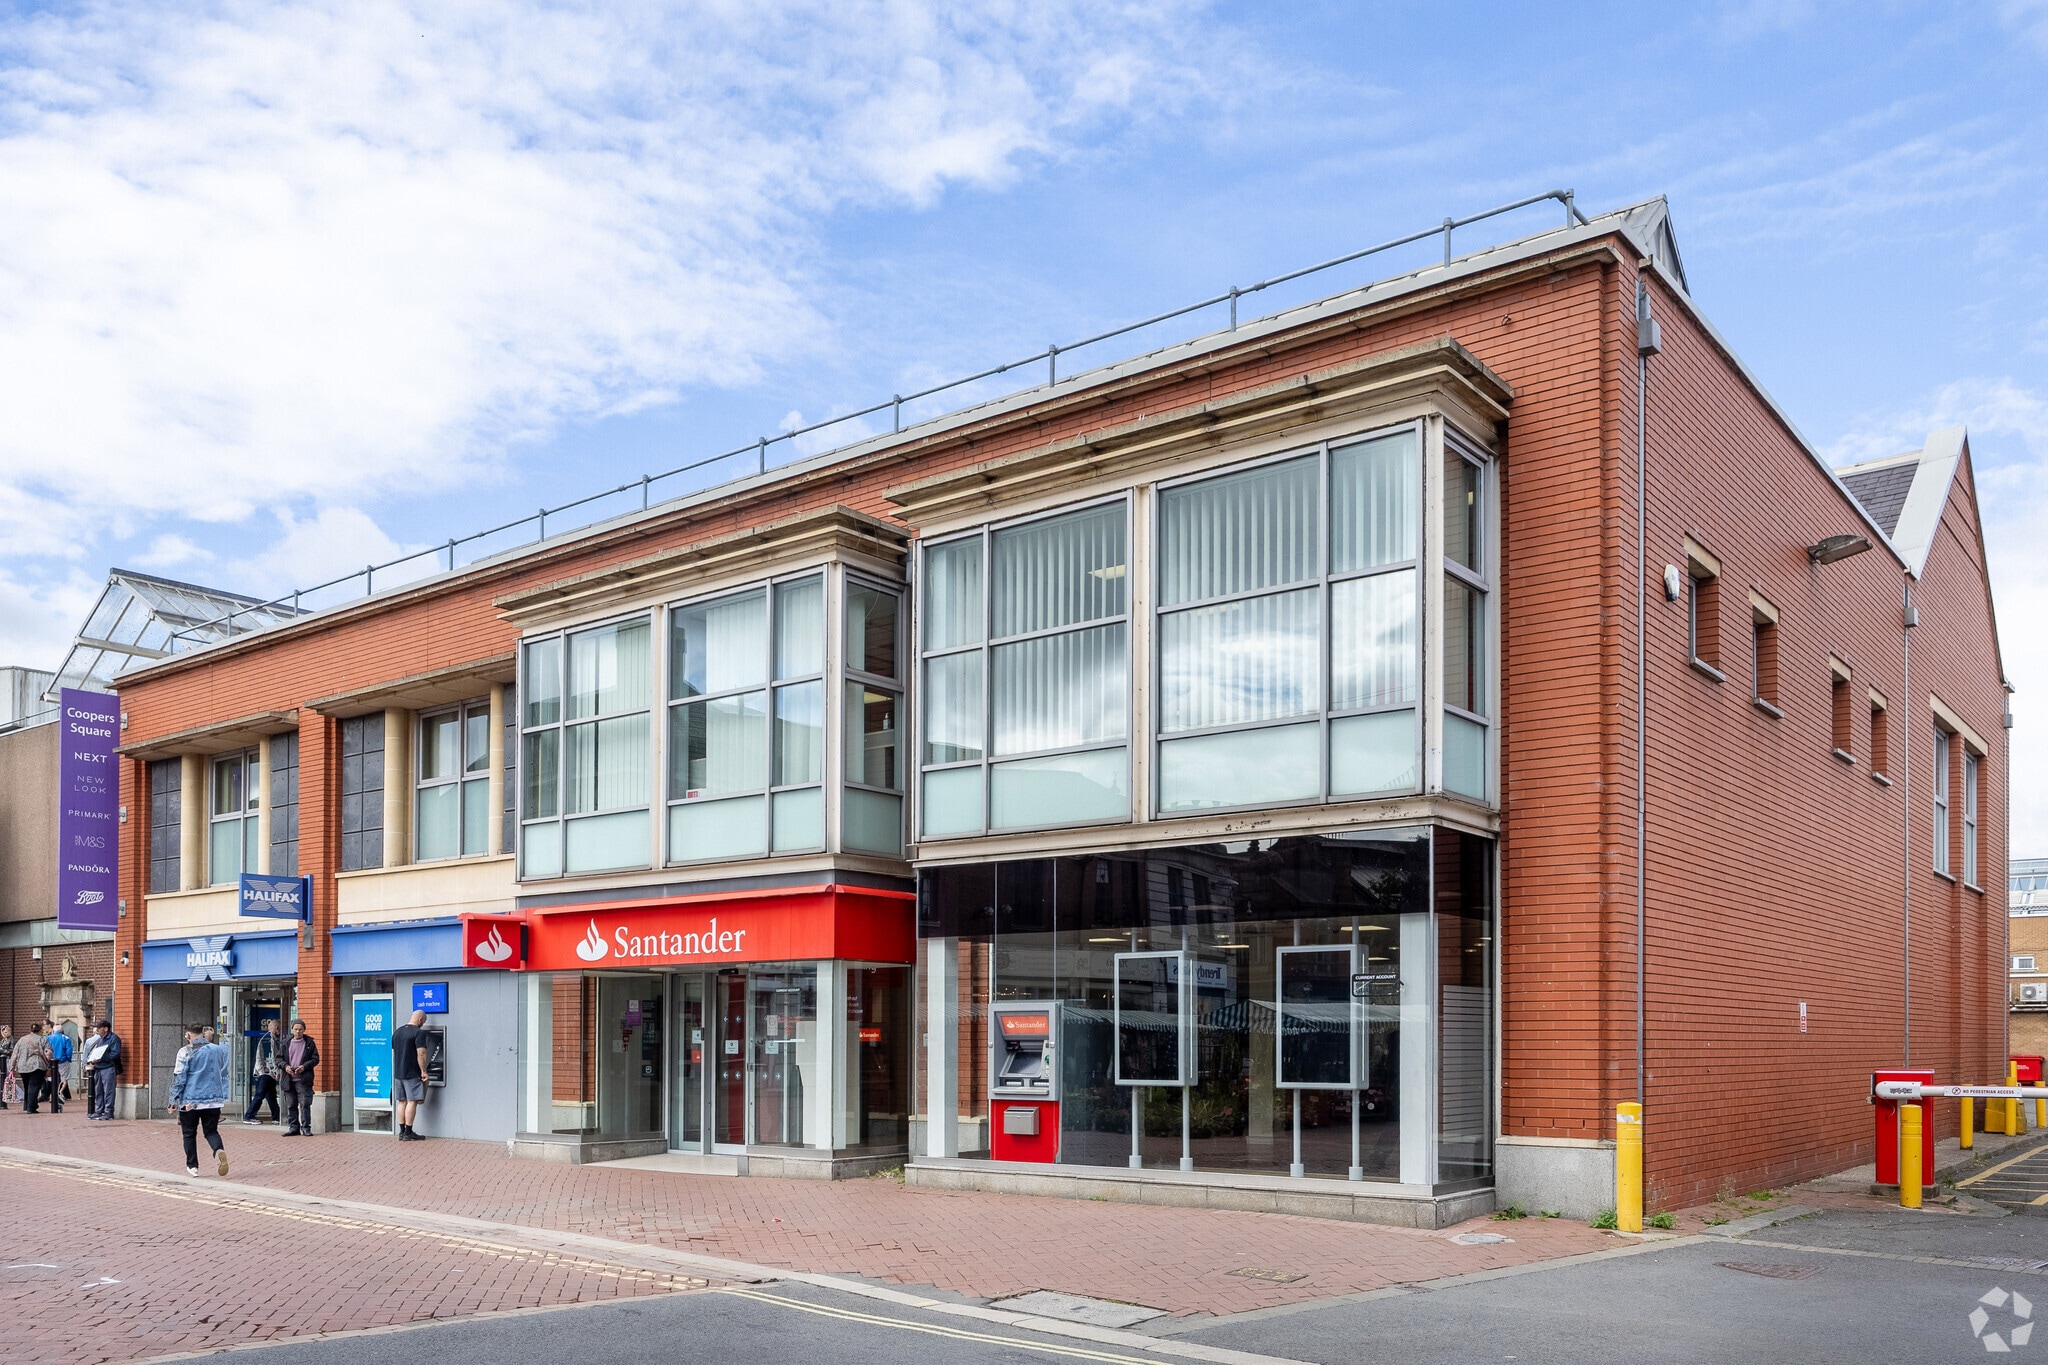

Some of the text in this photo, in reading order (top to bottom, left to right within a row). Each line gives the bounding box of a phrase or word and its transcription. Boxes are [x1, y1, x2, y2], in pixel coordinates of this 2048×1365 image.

[67, 707, 115, 723] Coopers
[70, 722, 112, 737] Square
[74, 752, 107, 763] NEXT
[77, 775, 105, 784] NEW
[74, 785, 106, 794] LOOK
[68, 809, 110, 820] PRIMARK
[79, 835, 105, 848] M&S
[243, 889, 300, 903] HALIFAX
[614, 917, 746, 959] Santander
[187, 951, 229, 967] HALIFAX
[365, 1014, 382, 1023] GOOD
[365, 1022, 382, 1031] MOVE
[1015, 1021, 1046, 1029] Santander
